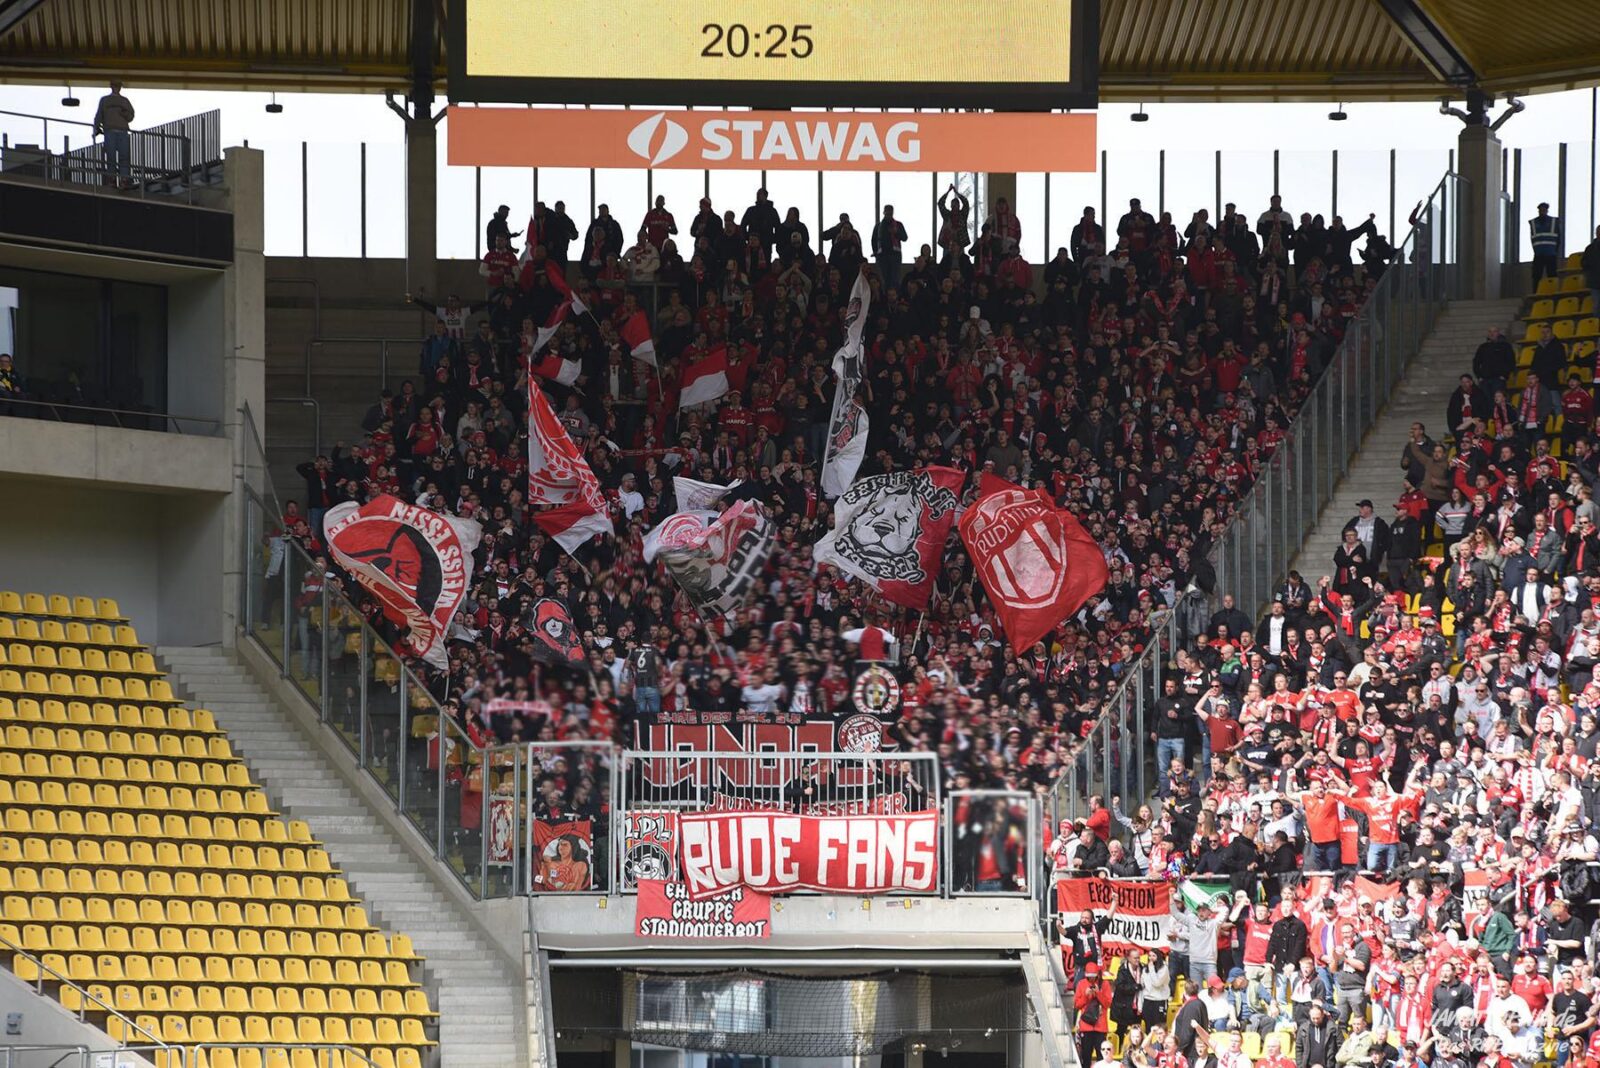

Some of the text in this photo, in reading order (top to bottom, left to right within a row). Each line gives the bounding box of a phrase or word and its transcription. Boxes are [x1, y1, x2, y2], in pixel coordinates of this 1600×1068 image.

[700, 23, 815, 59] 20:25
[701, 118, 921, 163] STAWAG
[389, 501, 453, 545] ESSEN
[637, 651, 646, 668] 6
[681, 817, 936, 893] RUDE FANS
[672, 900, 735, 921] GRUPPE
